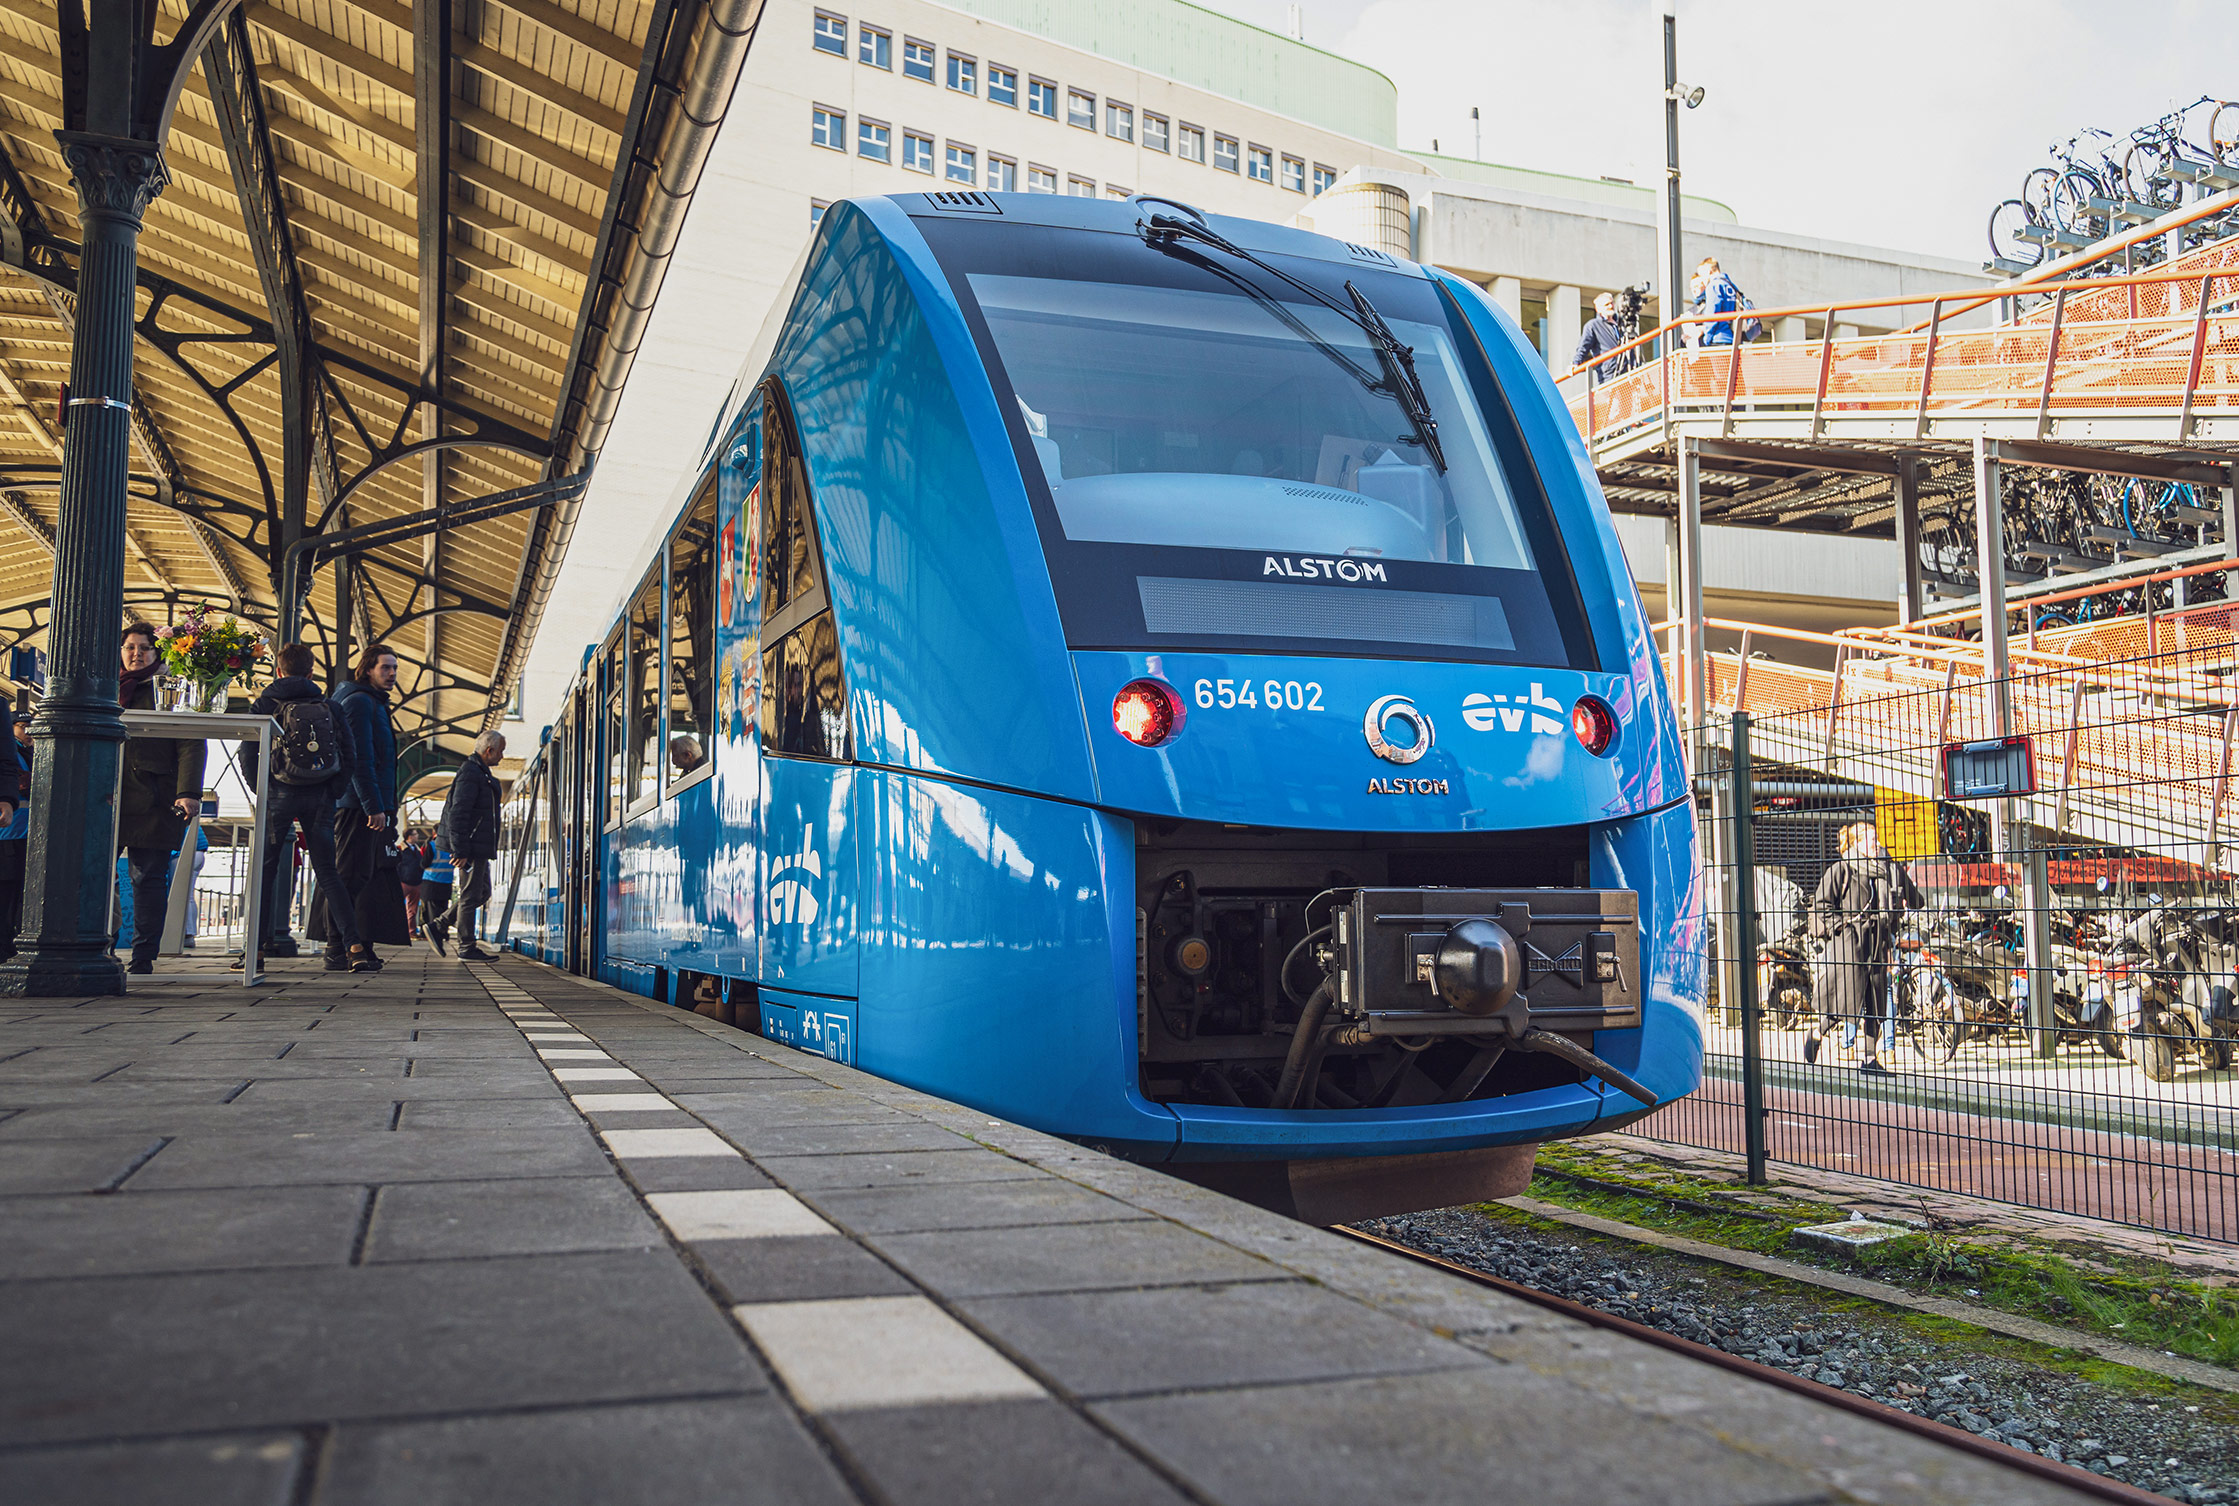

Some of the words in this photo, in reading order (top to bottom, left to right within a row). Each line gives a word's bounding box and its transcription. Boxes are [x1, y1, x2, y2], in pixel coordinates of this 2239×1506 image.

[1263, 556, 1388, 583] ALSTOM
[1194, 678, 1257, 709] 654
[1263, 679, 1325, 711] 602
[1462, 682, 1565, 735] evb
[1367, 777, 1450, 795] ALSTOM
[769, 822, 822, 926] evb
